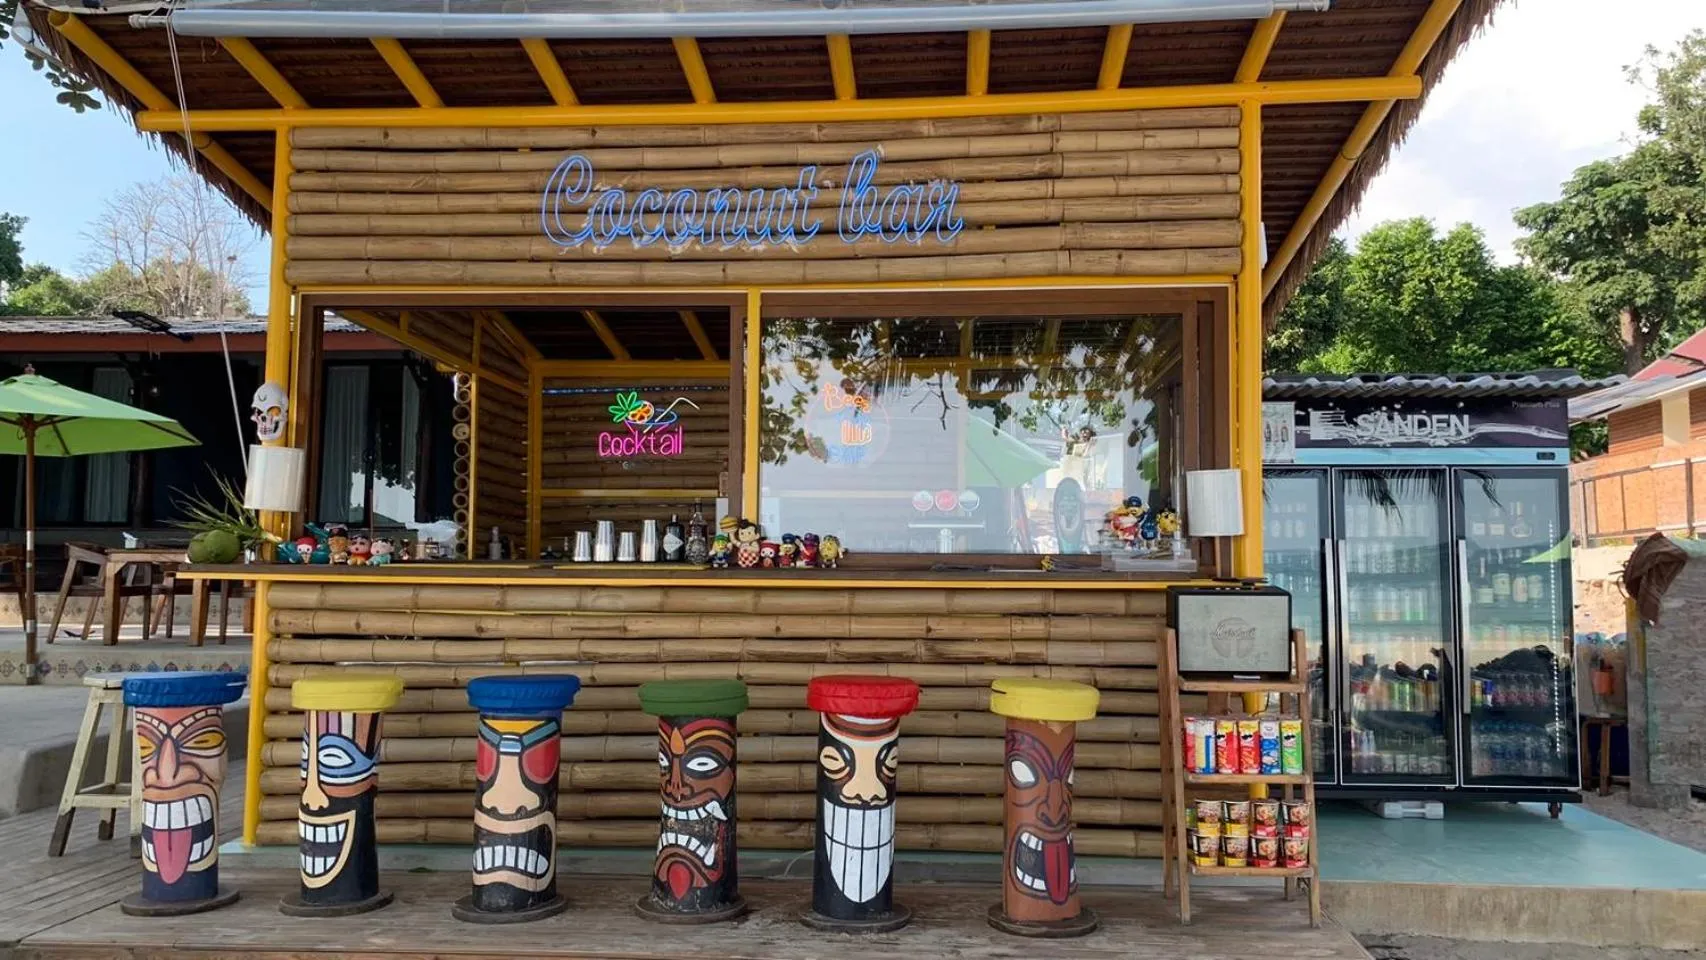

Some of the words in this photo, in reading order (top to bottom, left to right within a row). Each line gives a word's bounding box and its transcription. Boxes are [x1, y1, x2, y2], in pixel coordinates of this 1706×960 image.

[541, 155, 824, 246] Coconut
[838, 149, 967, 245] bar
[1355, 412, 1471, 438] SANDEN
[598, 426, 684, 457] Cocktail
